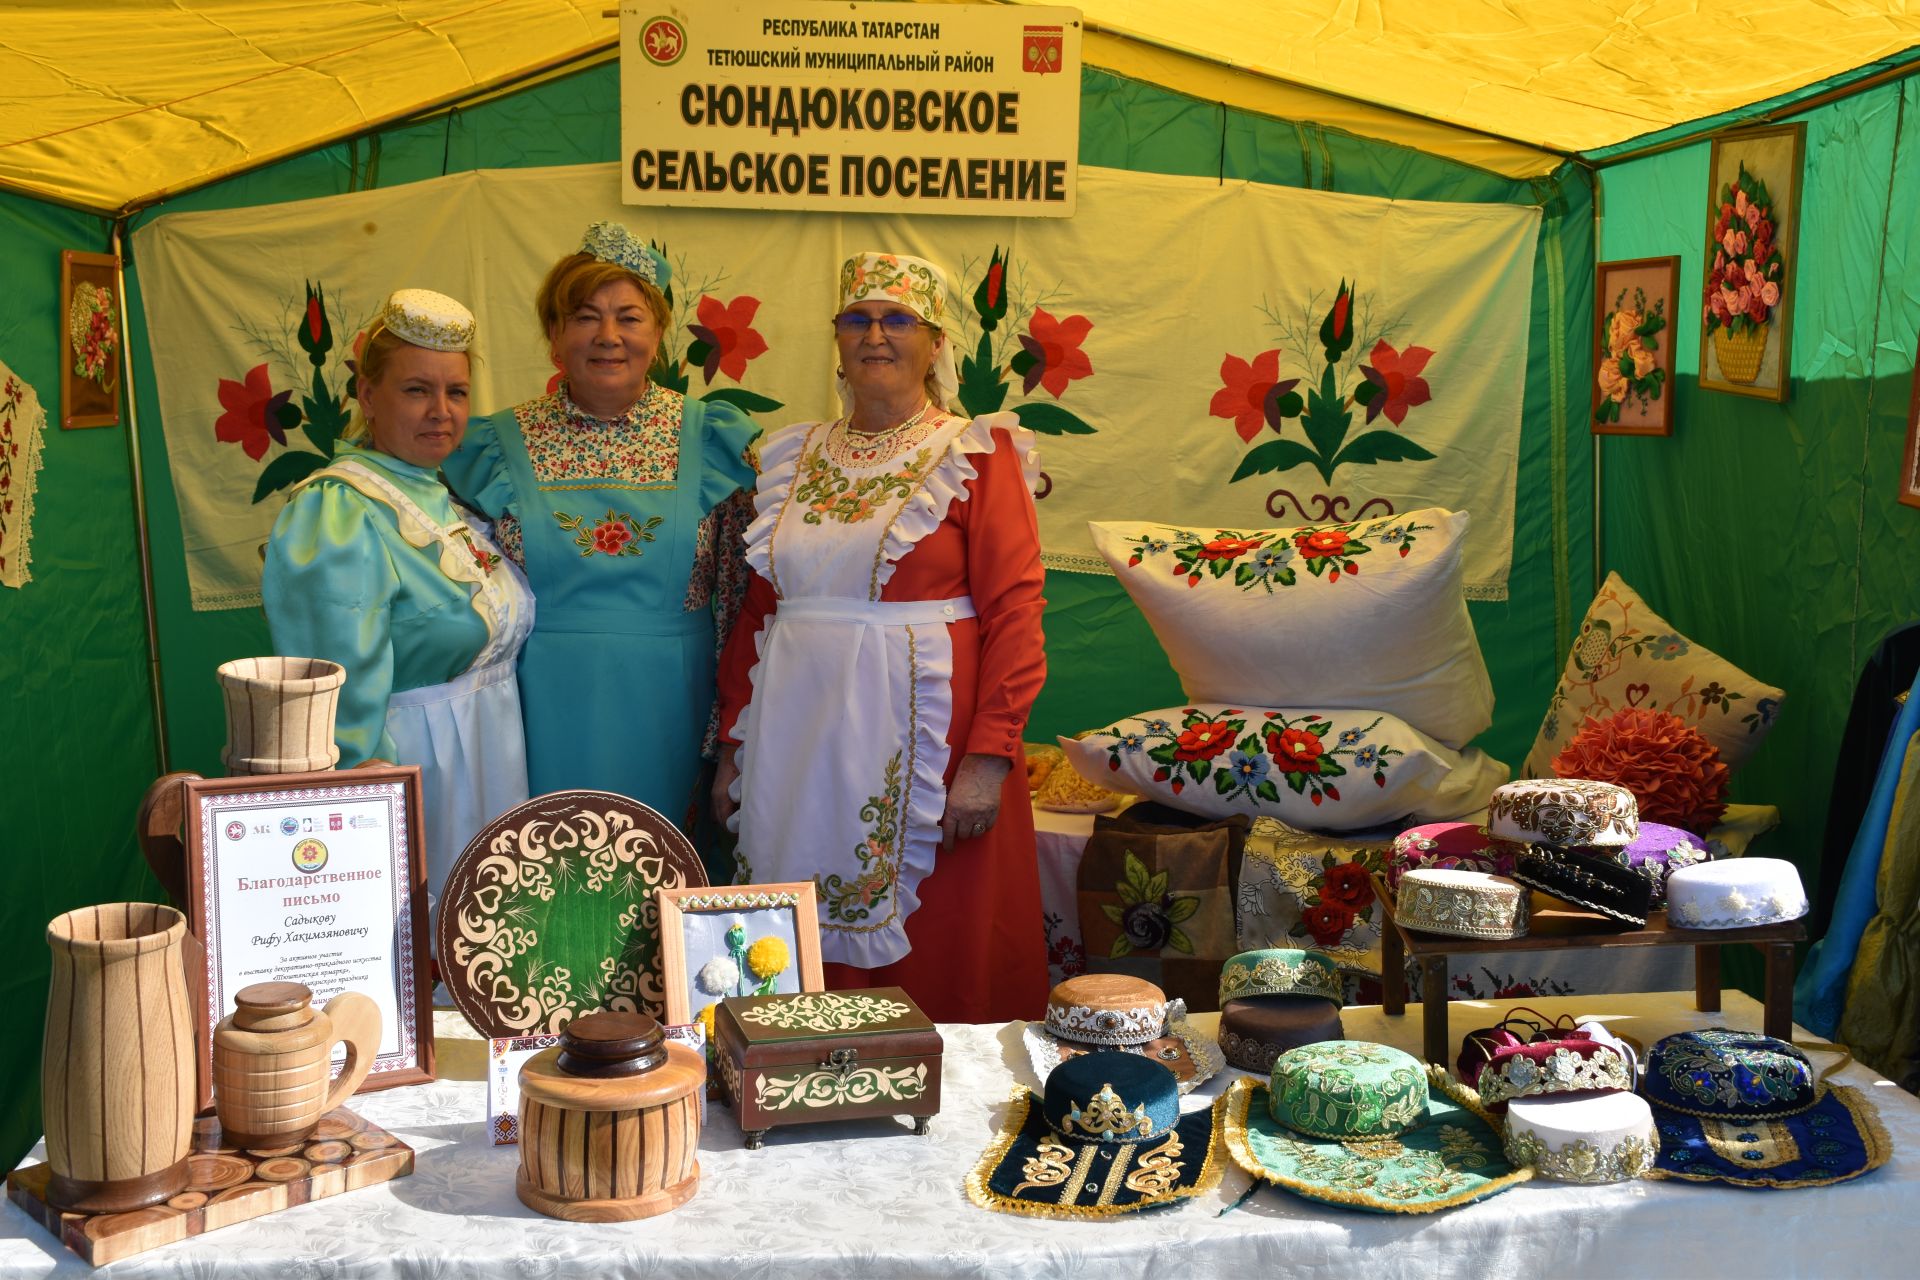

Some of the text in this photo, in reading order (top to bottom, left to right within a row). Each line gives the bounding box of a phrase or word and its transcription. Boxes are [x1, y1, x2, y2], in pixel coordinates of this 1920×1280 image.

[762, 19, 940, 40] РЕСПУБЛИКА ТАТАРСТАН
[707, 47, 994, 73] ТЕТЮШСКИЙ МУНИЦИПАЛЬНЫЙ РАЙОН
[680, 83, 1020, 137] СЮНДЮКОВСКОЕ
[632, 149, 1067, 202] СЕЛЬСКОЕ ПОСЕЛЕНИЕ
[237, 869, 382, 891] Благодарственное
[283, 892, 341, 907] письмо
[284, 913, 336, 928] Садыкову
[251, 926, 369, 948] Рифу Хакимзяновичу
[243, 968, 273, 976] выставке
[352, 956, 382, 964] искусства
[288, 954, 317, 963] активное
[318, 951, 343, 960] участие
